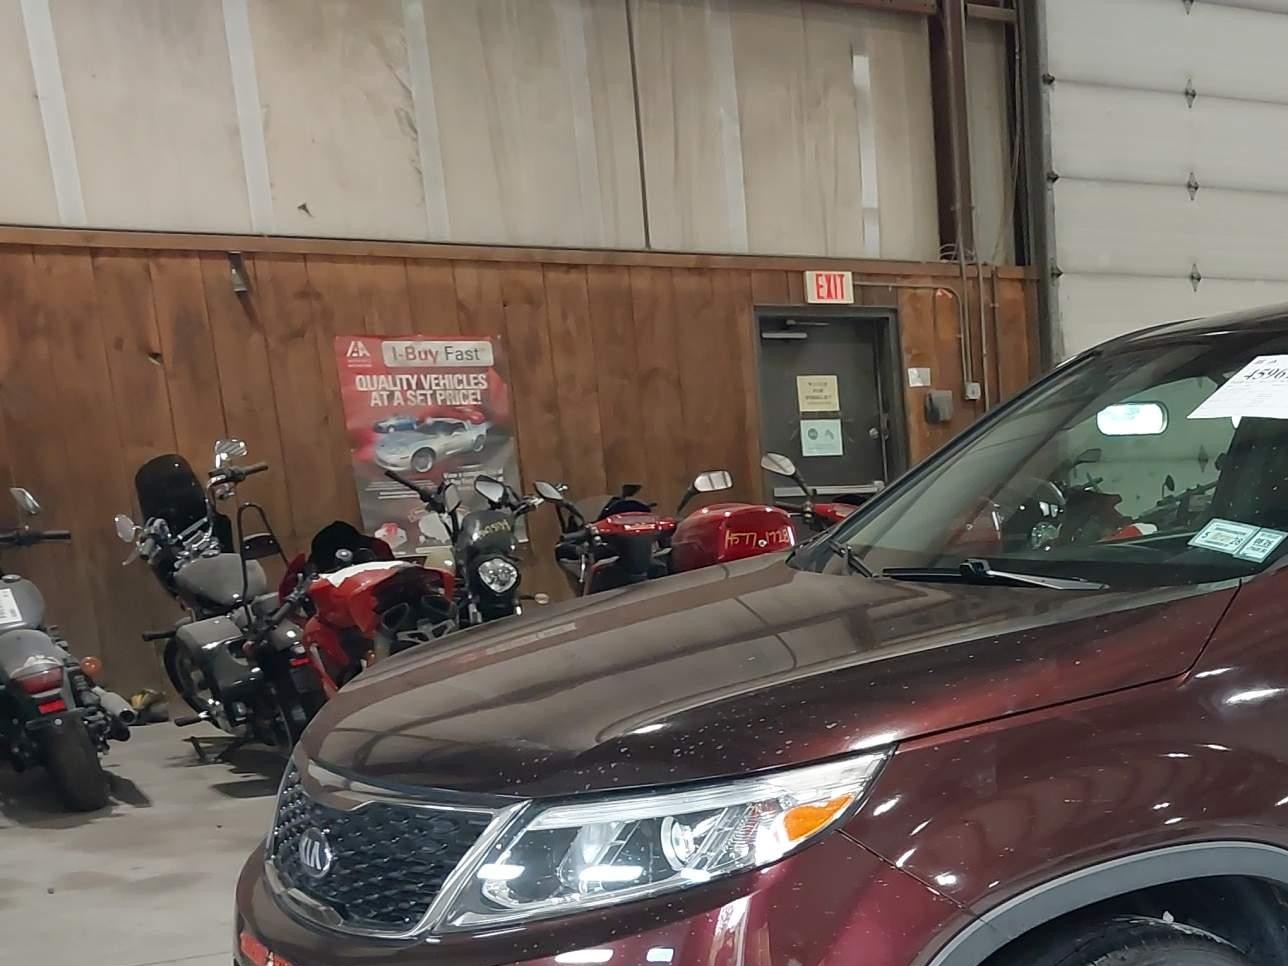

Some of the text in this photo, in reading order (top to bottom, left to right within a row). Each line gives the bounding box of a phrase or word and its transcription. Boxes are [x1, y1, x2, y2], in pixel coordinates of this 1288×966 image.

[816, 274, 845, 299] EXIT
[392, 346, 480, 364] I-Buy Fast
[355, 374, 488, 391] QUALITY VEHICLES
[370, 390, 482, 406] AT A SET PRICE!
